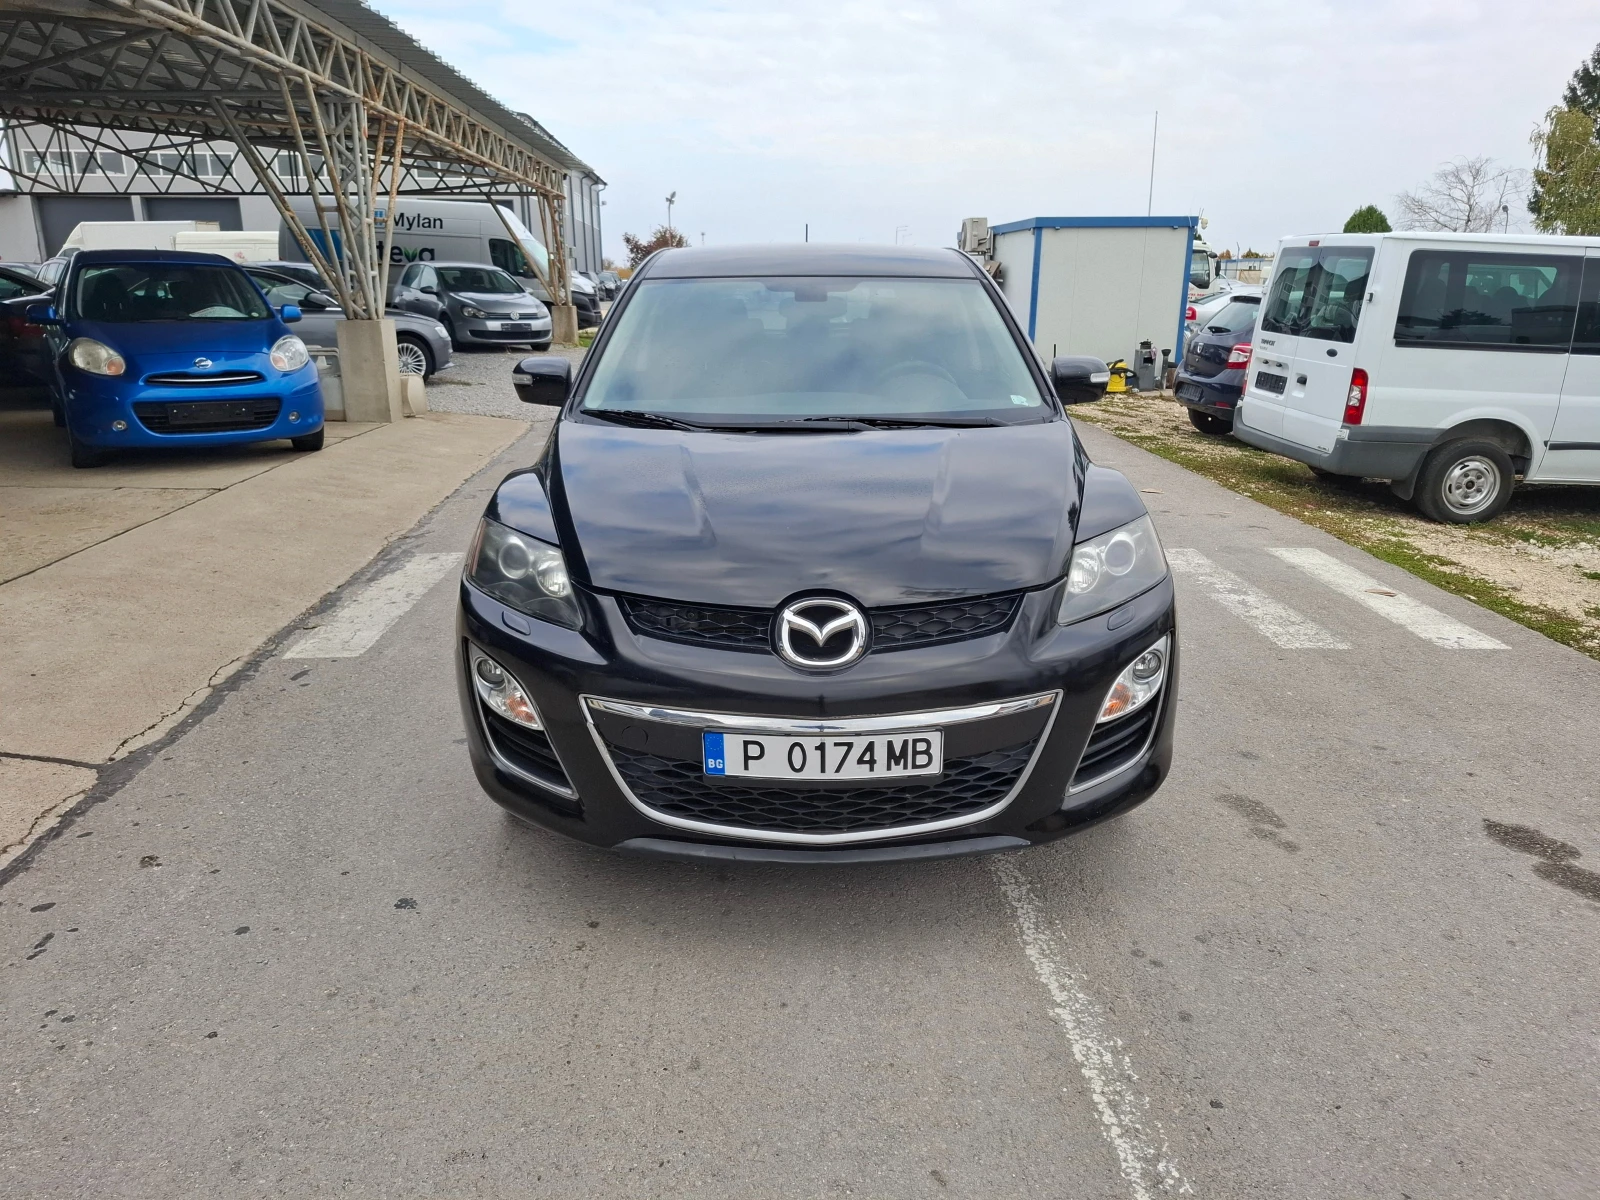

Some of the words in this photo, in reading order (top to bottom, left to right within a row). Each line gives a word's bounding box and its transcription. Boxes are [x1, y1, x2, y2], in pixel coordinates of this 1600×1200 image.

[393, 212, 444, 231] Mylan
[707, 758, 724, 769] BG
[742, 739, 766, 771] P
